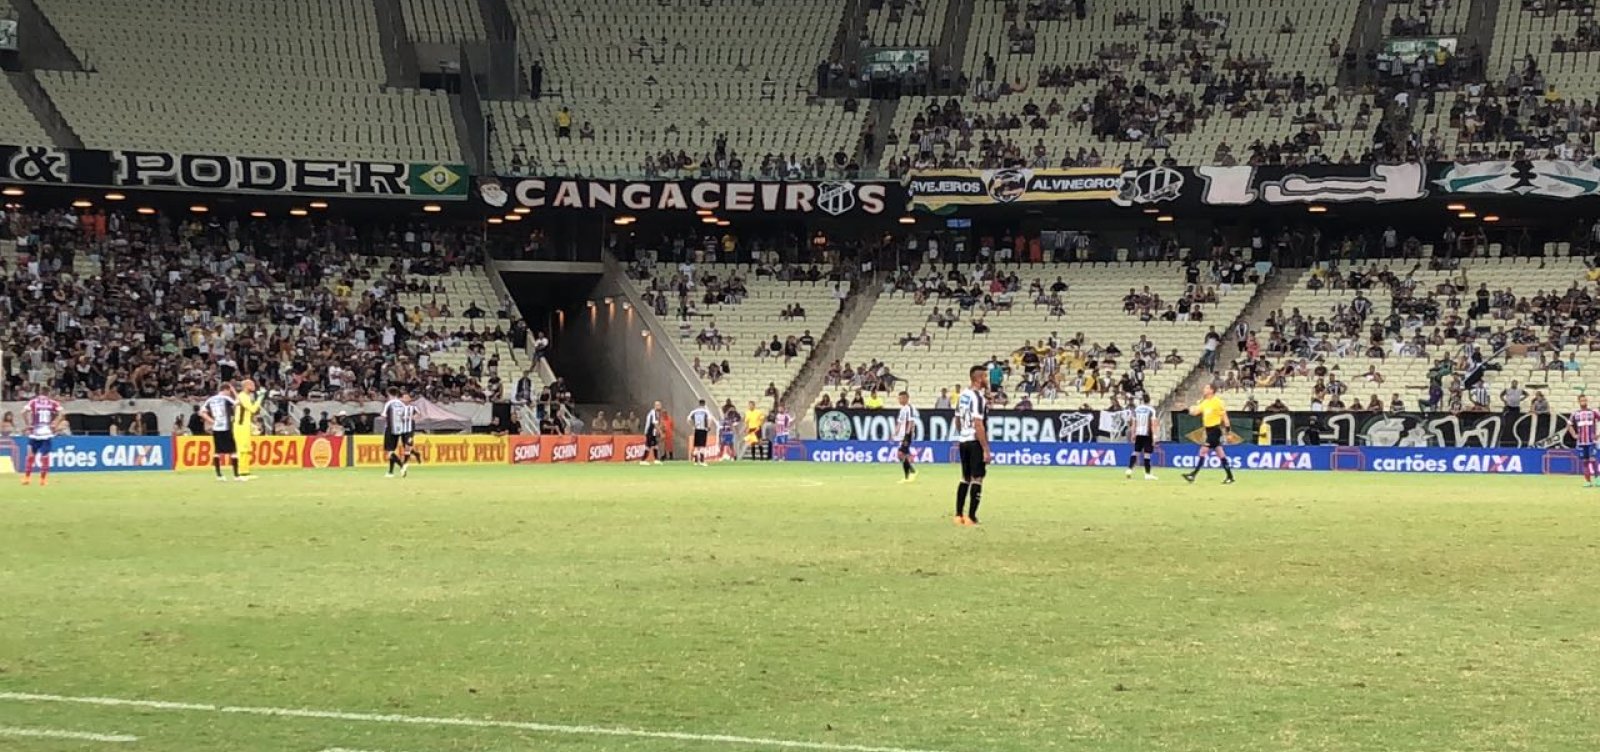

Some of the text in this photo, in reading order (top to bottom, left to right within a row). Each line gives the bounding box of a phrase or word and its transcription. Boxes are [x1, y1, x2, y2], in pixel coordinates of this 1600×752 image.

[114, 150, 410, 195] PODER
[910, 180, 980, 193] RVEJEIROS
[514, 179, 885, 214] CANGACEIRS
[987, 415, 1056, 442] ERRA
[102, 445, 163, 467] CAIXA
[183, 440, 297, 467] GBOSA
[514, 444, 540, 461] SCHIN
[553, 444, 578, 461] SCHIN
[589, 444, 614, 461] SCHIN
[625, 444, 646, 461] SCHI
[812, 446, 935, 463] cartões CAXA
[1055, 448, 1117, 466] CAIXA
[1247, 451, 1313, 469] CAIXA
[1373, 454, 1523, 473] cartões CAIXA
